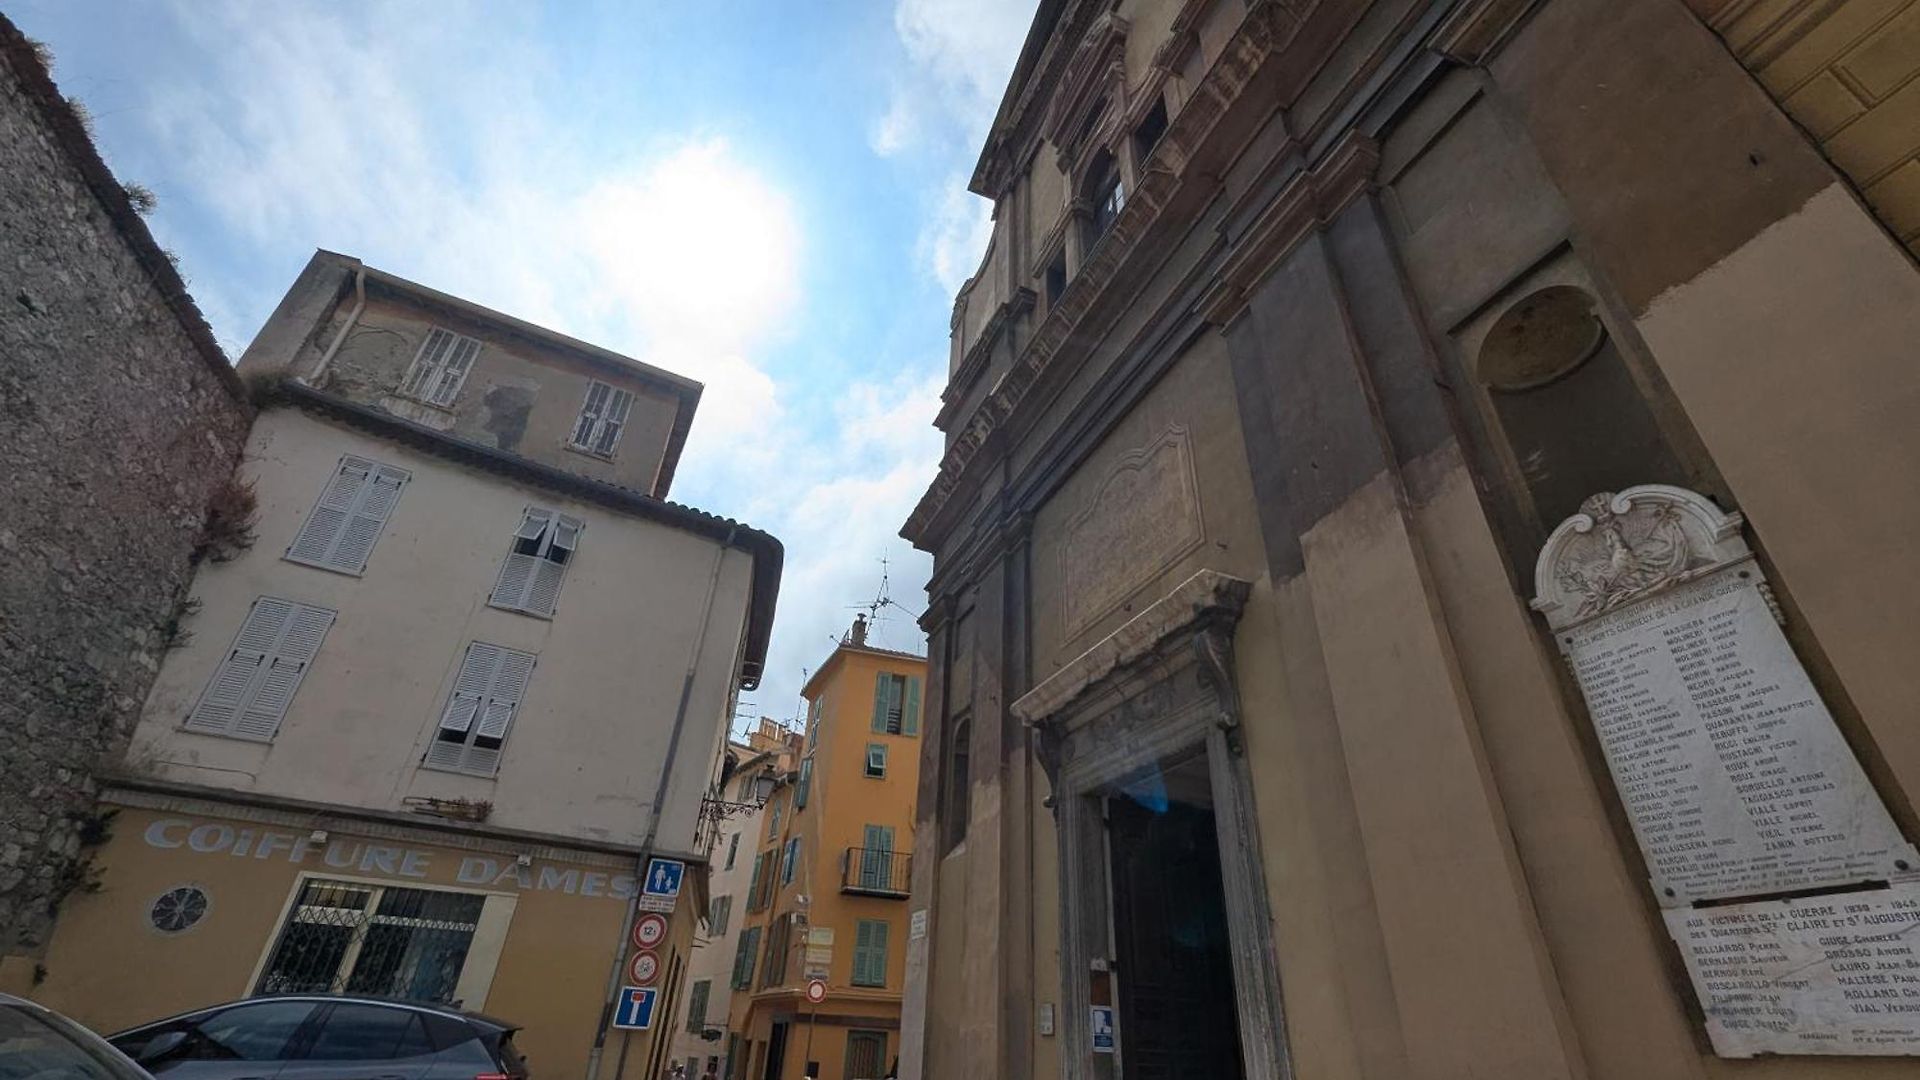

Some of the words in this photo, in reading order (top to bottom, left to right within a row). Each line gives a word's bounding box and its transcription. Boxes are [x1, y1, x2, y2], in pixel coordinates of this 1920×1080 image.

[1747, 804, 1778, 816] VIALE
[1752, 815, 1783, 827] VIALE
[457, 856, 637, 900] DAMES
[1707, 912, 1756, 927] VICTIMES
[1756, 912, 1771, 922] DE
[1771, 911, 1786, 920] LA
[1788, 905, 1837, 919] GUERRE
[1786, 919, 1830, 932] CLAIRE
[1832, 919, 1847, 928] ET
[1830, 961, 1871, 973] LAURO
[1850, 1002, 1881, 1014] VIAL
